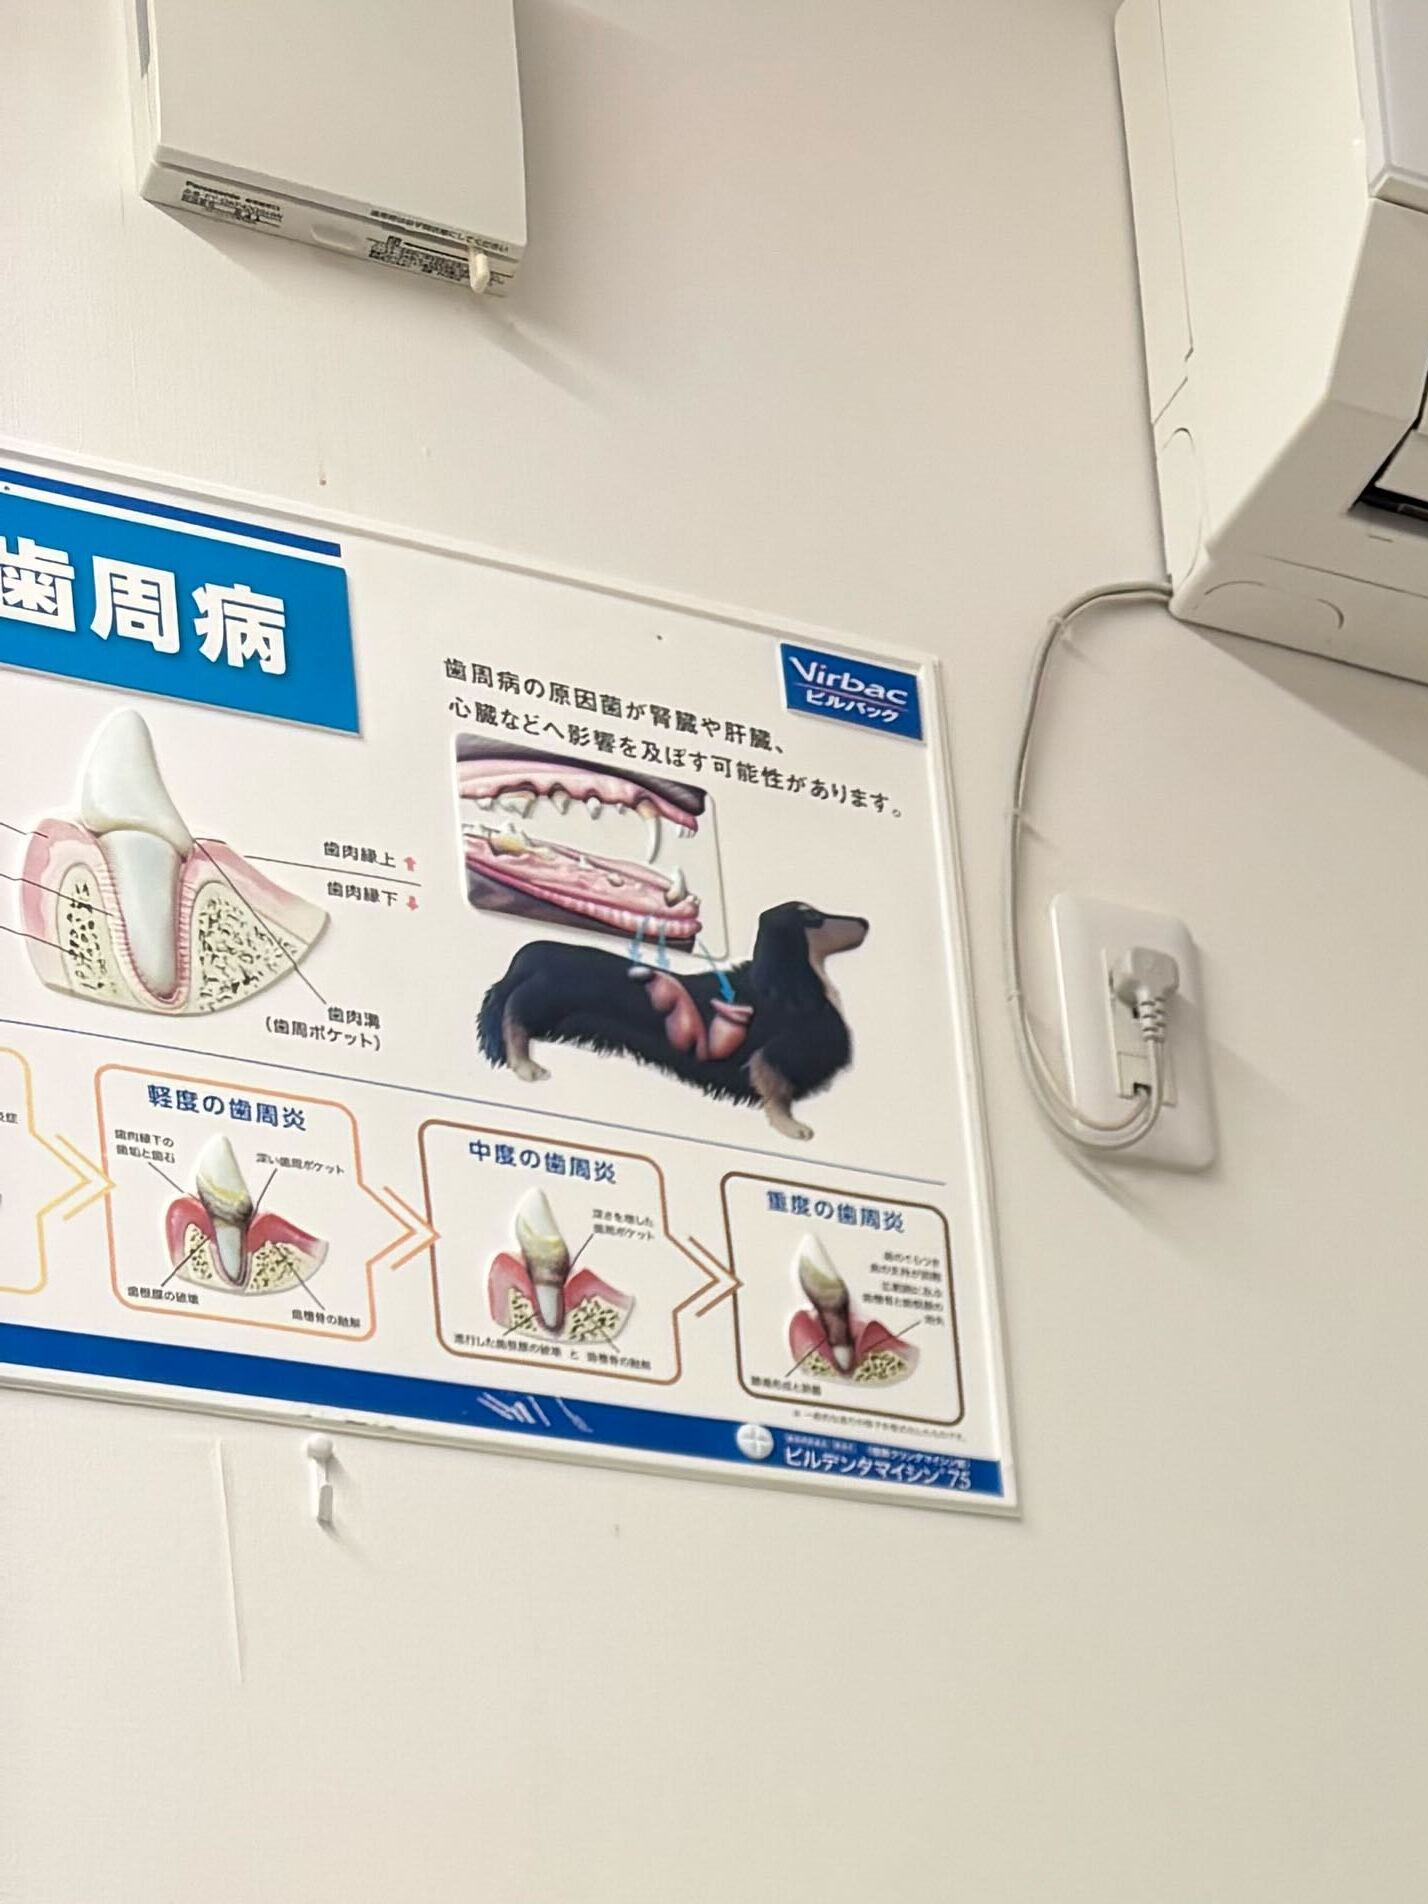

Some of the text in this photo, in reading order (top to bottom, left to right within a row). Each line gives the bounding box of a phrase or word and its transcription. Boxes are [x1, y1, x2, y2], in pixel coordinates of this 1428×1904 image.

[0, 536, 287, 675] 歯周病
[444, 657, 784, 754] 歯周病の原因菌が腎臓や肝臓、
[789, 656, 908, 706] Virbac
[805, 688, 899, 723] ビルバック
[448, 695, 902, 819] 心臓などへ影響を及ぼす可能性があります。
[148, 1084, 307, 1132] 軽度の歯周炎
[469, 1139, 617, 1184] 中度の歯周炎
[767, 1189, 905, 1234] 重度の歯周炎
